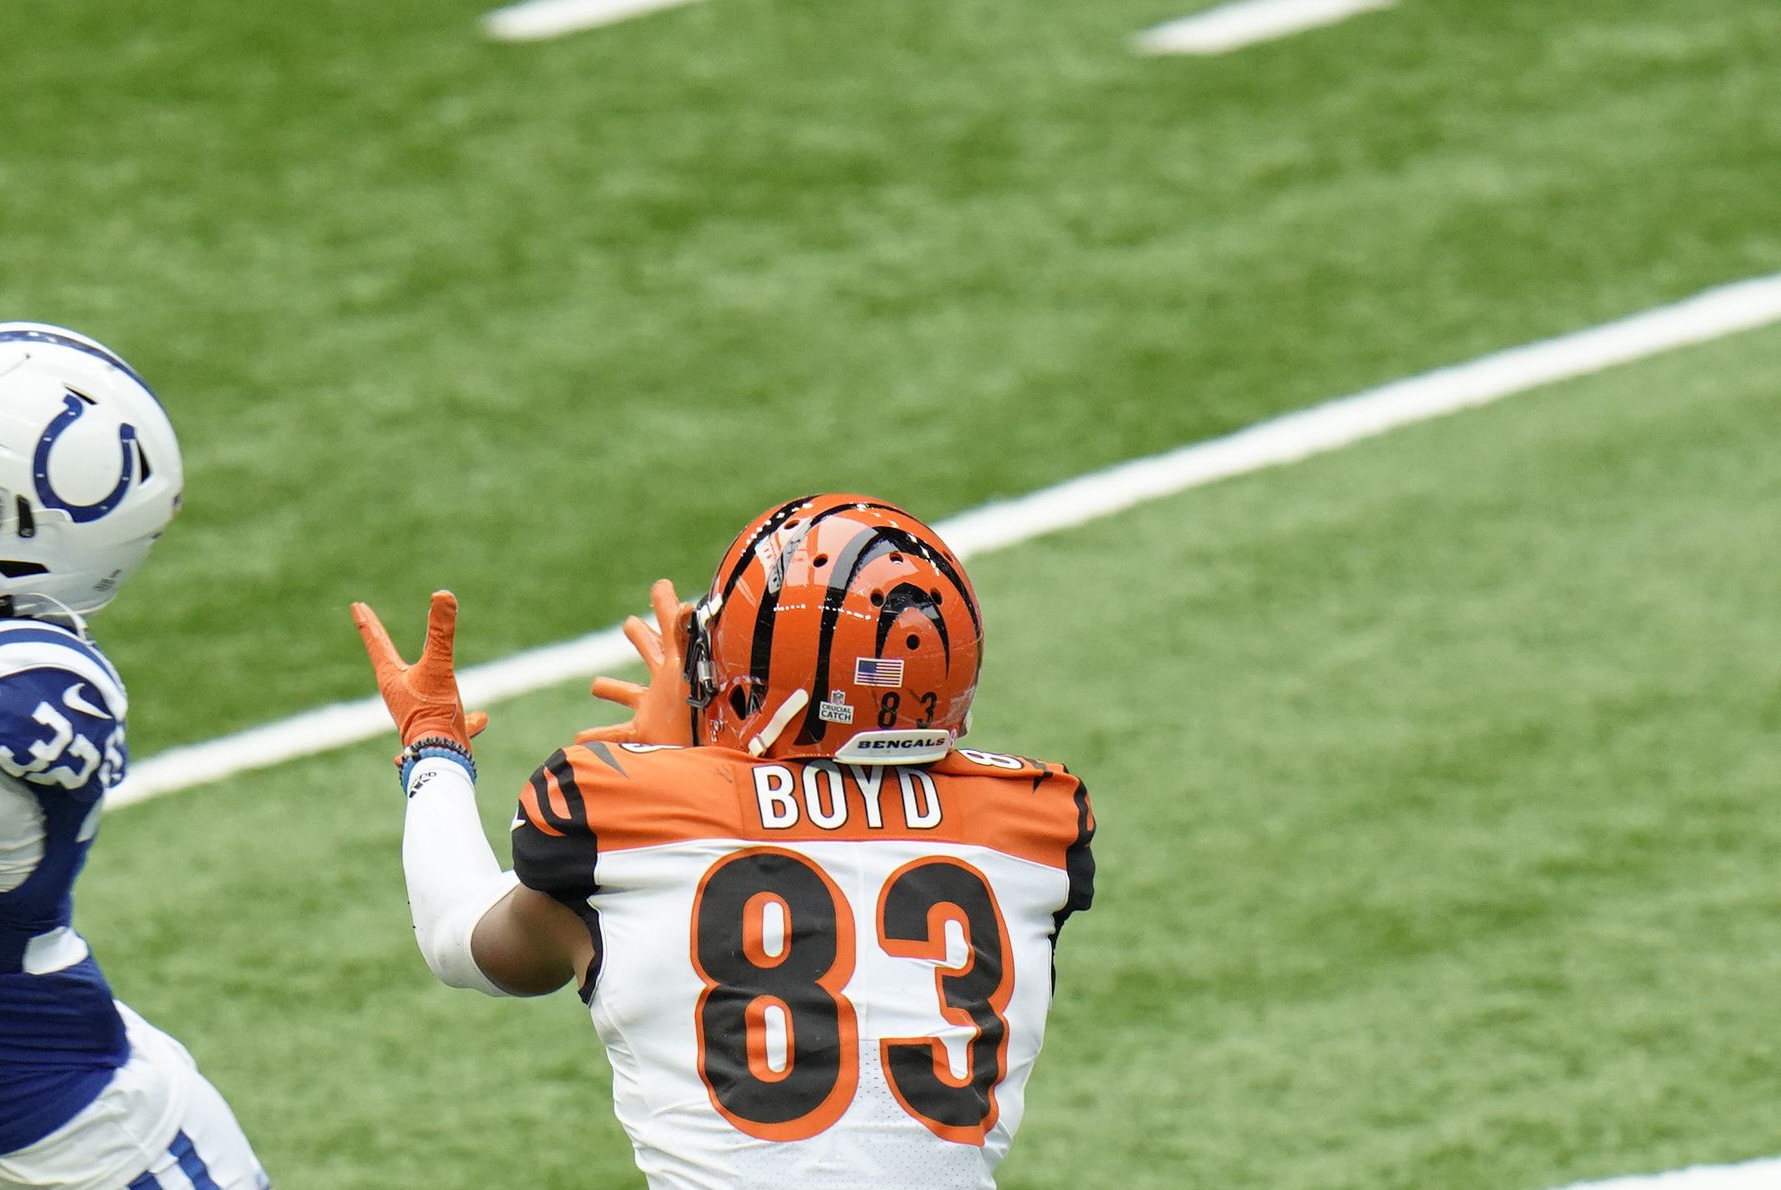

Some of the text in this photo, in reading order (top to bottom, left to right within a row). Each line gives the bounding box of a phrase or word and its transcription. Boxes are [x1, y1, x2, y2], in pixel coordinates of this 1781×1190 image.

[821, 703, 852, 714] CRUCIAL
[821, 710, 852, 721] CATCH
[857, 737, 946, 749] BENGALS
[751, 760, 943, 830] BOYD
[690, 846, 1016, 1146] 83
